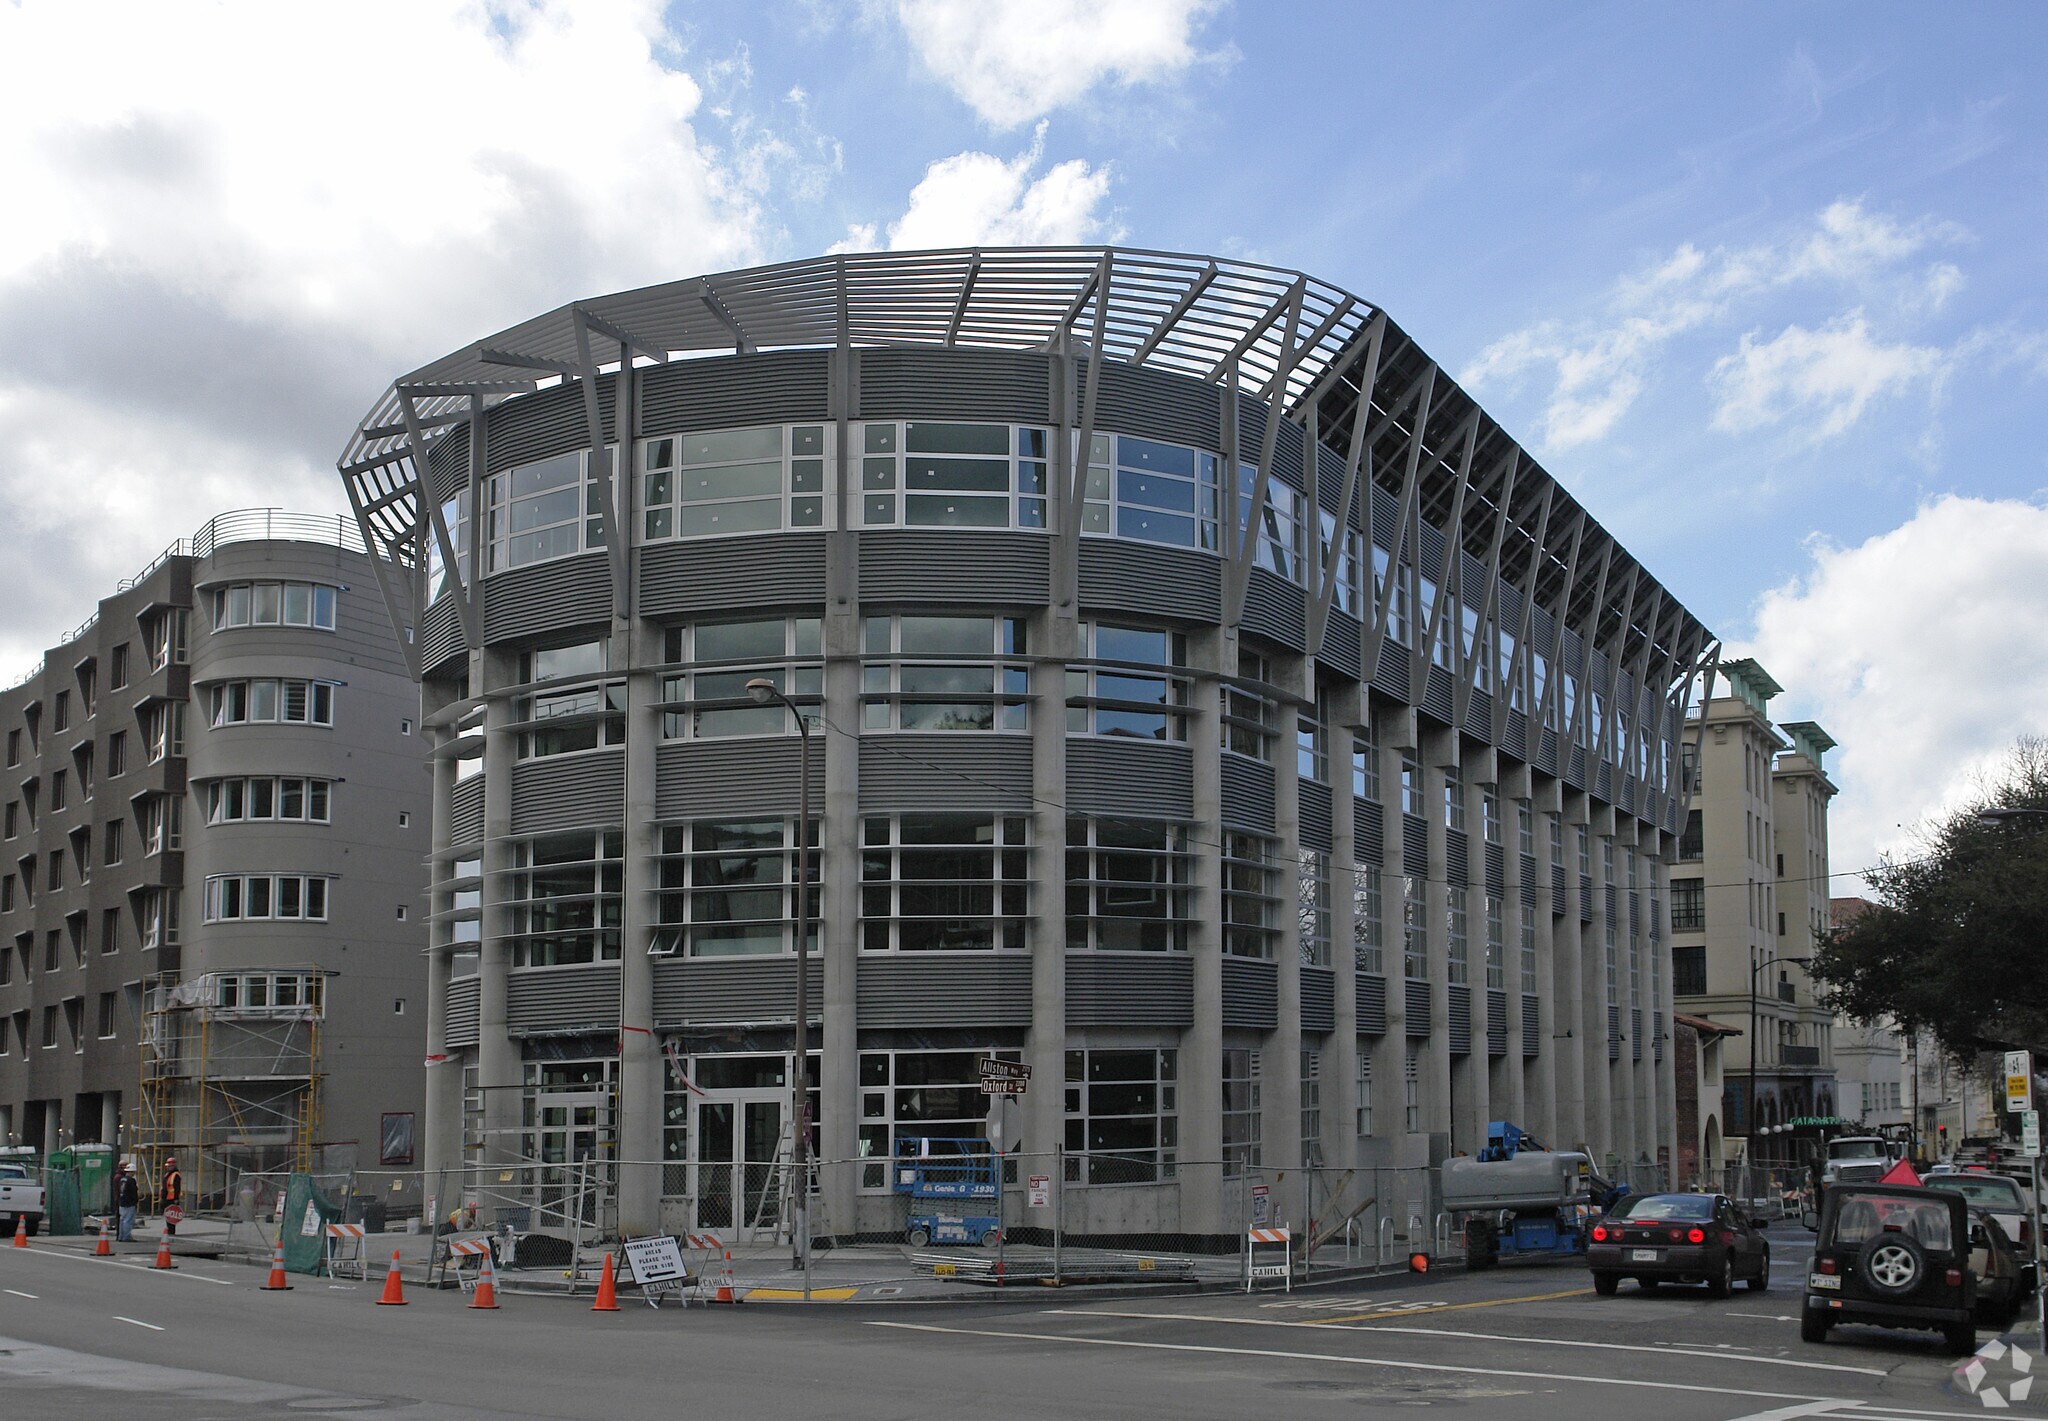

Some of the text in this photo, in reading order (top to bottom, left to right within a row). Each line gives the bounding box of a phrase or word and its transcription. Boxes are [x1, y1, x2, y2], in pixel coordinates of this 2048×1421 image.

[982, 1061, 1008, 1075] Allston
[983, 1080, 1008, 1092] Oxford
[1791, 1117, 1814, 1125] GAIA
[1030, 1180, 1039, 1188] NO
[934, 1185, 956, 1193] Genie
[165, 1210, 183, 1220] STOP
[654, 1239, 675, 1247] CLOSED
[332, 1261, 362, 1269] CAHILL
[1252, 1267, 1284, 1276] CAHILL
[647, 1280, 678, 1293] CAHILL
[705, 1278, 730, 1287] CAHILL
